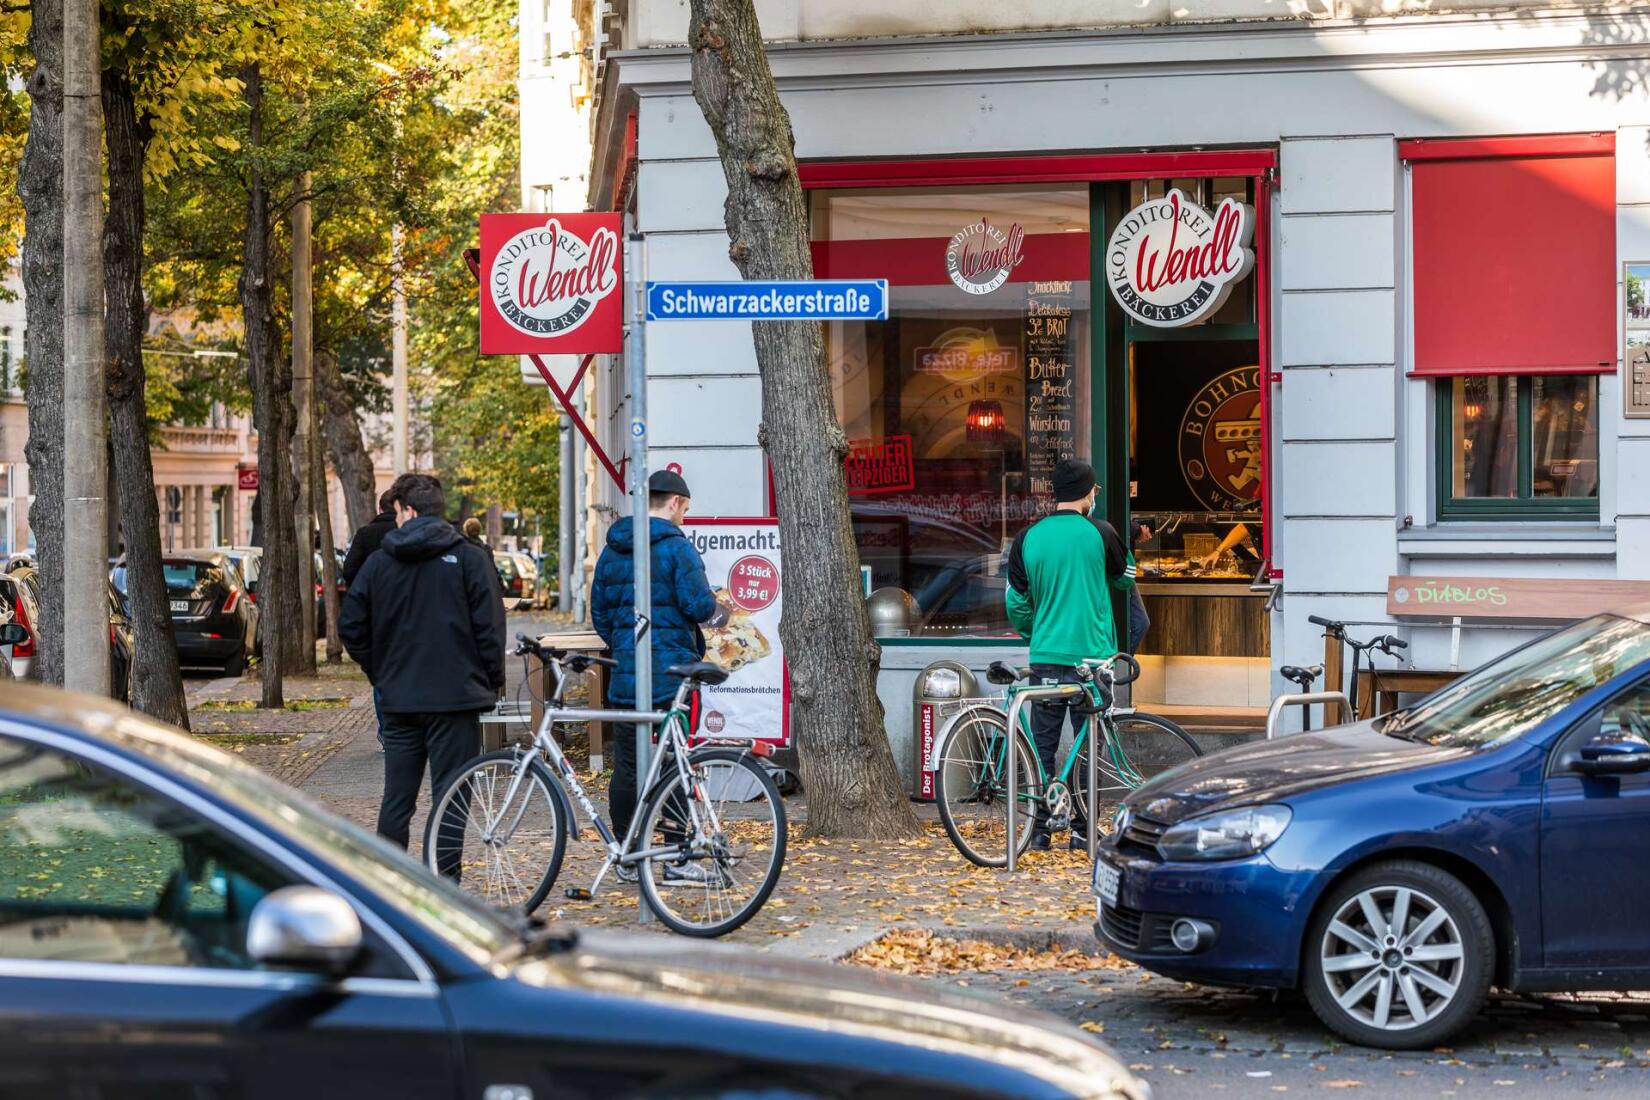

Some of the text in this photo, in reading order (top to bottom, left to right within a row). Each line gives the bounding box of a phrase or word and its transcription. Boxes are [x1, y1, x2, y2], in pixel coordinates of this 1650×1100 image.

[947, 223, 1007, 271] KONDITOREI
[962, 217, 1024, 278] Wendl
[1112, 204, 1211, 283] KONDITOREI
[1136, 193, 1240, 292] Wendl
[495, 231, 587, 299] KONDITOREI
[518, 223, 614, 308] Wendl
[505, 302, 588, 332] BÄCKEREI
[661, 288, 870, 314] Schwarzackerstraße
[1120, 285, 1211, 320] BÄCKEREI
[1029, 357, 1072, 380] Butter
[738, 565, 772, 578] 3 Stück
[737, 587, 758, 600] 3,99
[709, 686, 781, 694] Reformationsbrötchen
[922, 775, 931, 794] Der
